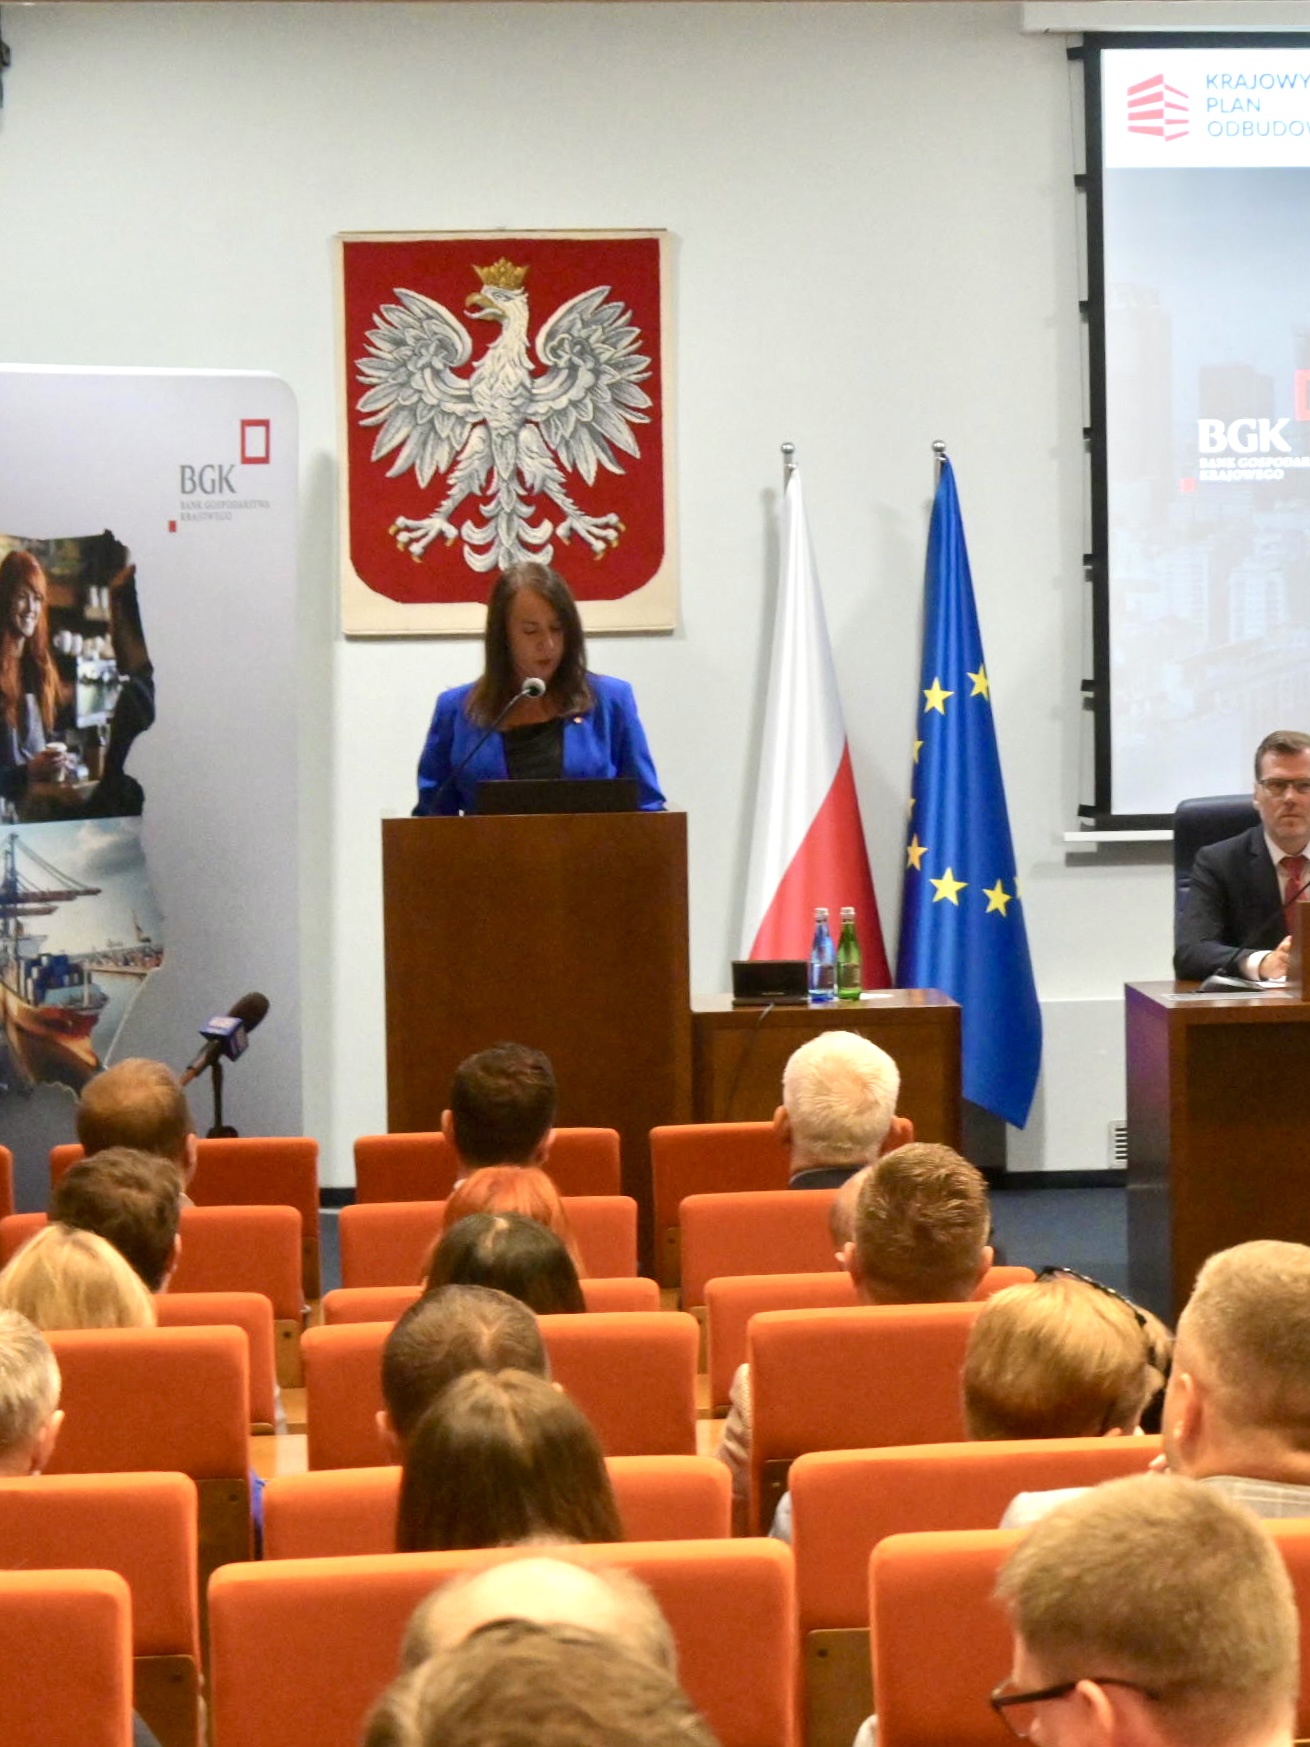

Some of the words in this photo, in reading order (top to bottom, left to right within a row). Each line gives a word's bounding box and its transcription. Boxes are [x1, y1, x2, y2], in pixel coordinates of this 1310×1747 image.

[1206, 97, 1261, 113] PLAN
[1196, 417, 1293, 454] BGK
[1198, 456, 1237, 469] BANK
[179, 464, 237, 495] BGK
[1198, 468, 1286, 482] KRAJOWEGO
